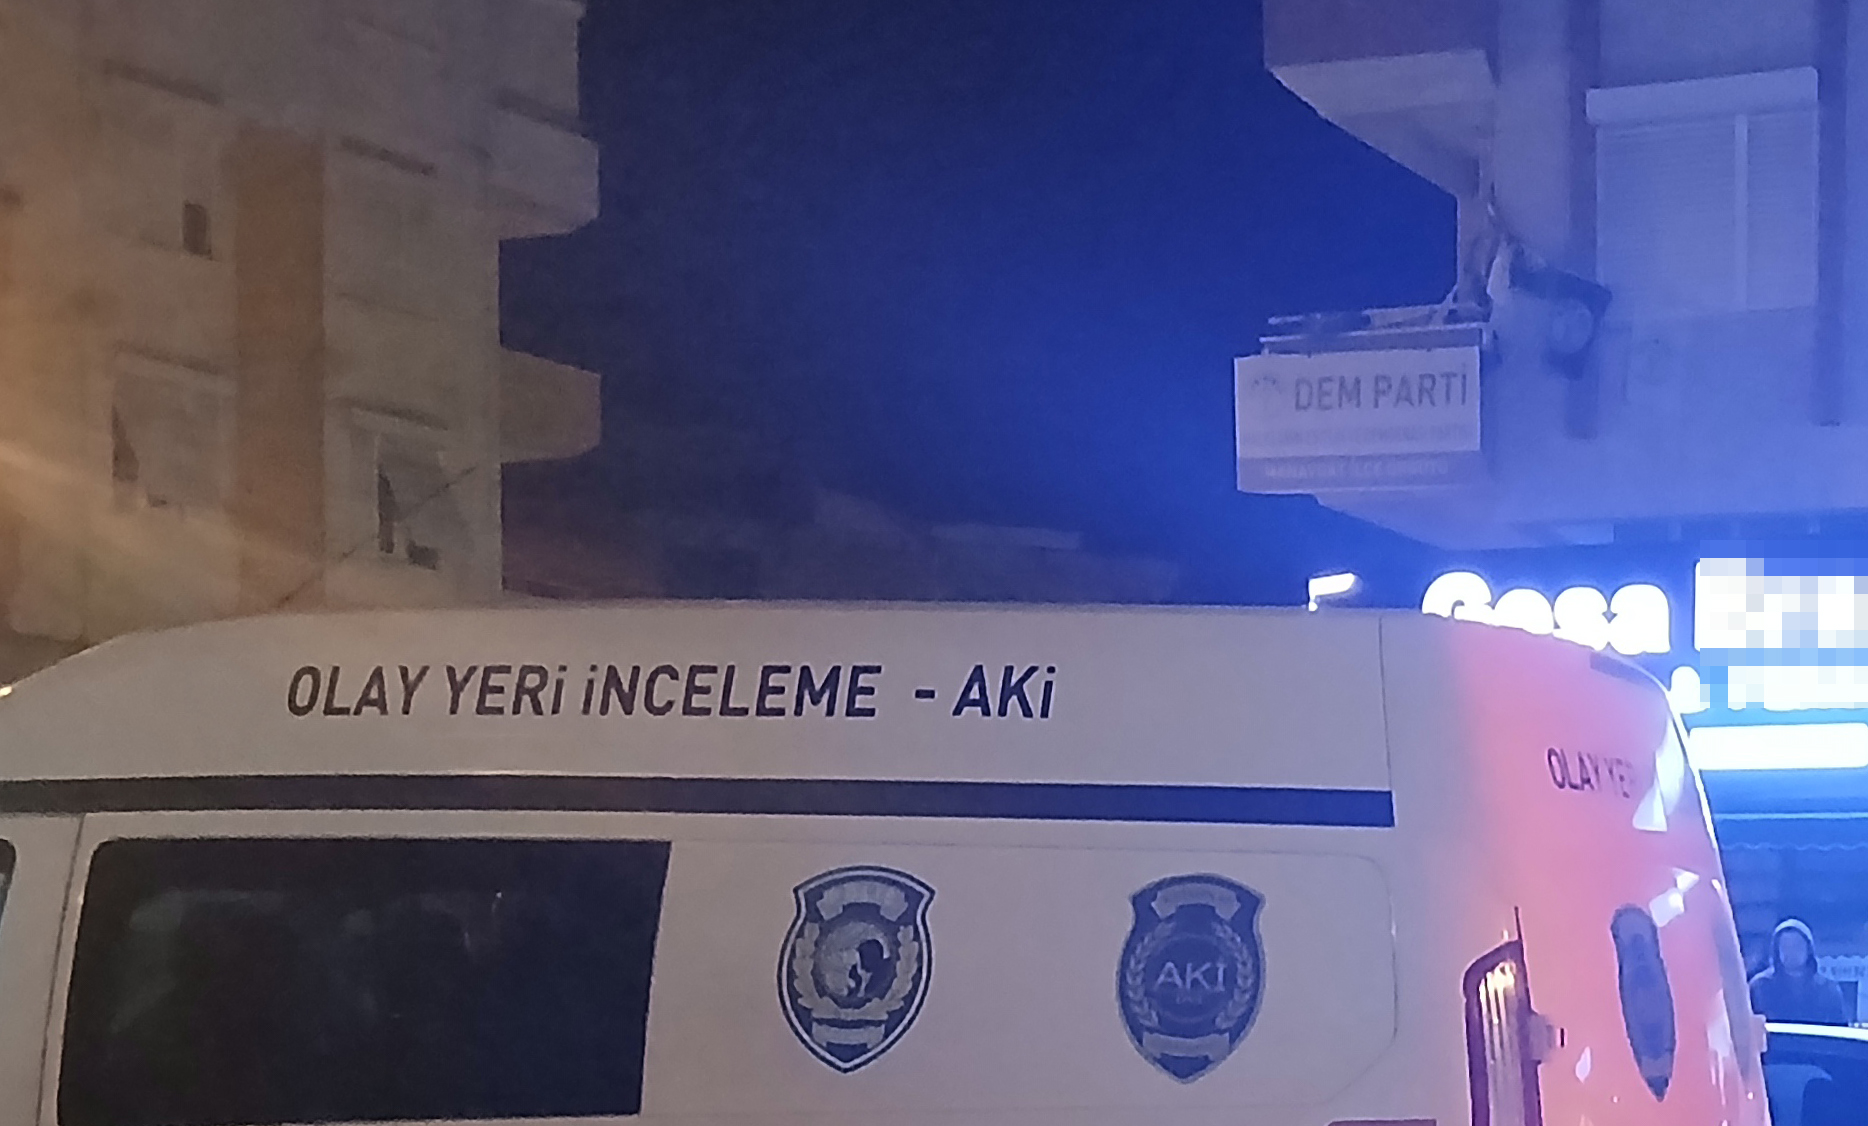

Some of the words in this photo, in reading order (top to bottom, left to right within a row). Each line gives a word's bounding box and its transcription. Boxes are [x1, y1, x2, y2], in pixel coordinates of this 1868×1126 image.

[1295, 374, 1362, 412] DEM
[286, 663, 430, 718] OLAY
[1547, 747, 1602, 792] OLAY
